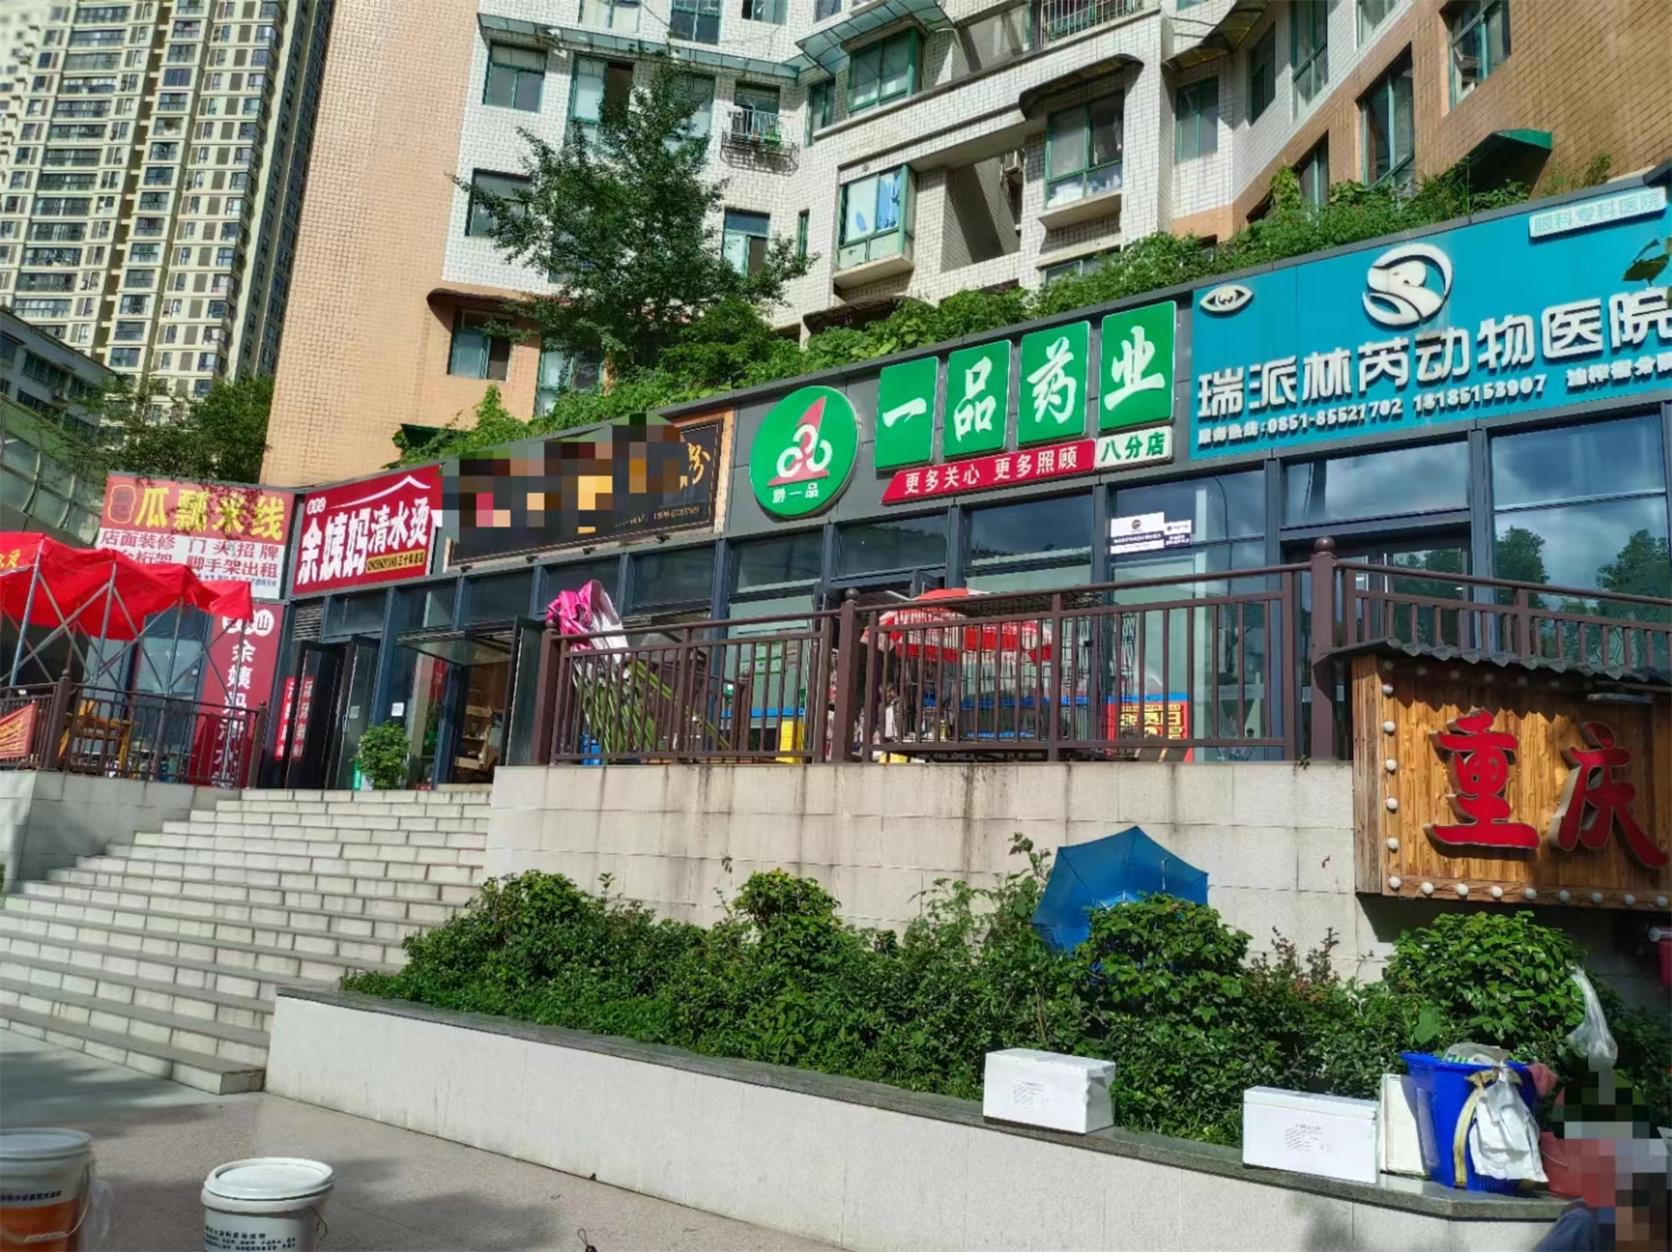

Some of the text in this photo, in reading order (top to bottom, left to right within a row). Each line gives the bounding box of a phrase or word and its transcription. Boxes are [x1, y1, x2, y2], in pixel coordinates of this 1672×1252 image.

[1198, 287, 1672, 418] 瑞派林芮动物医院
[882, 326, 1166, 442] 一品药业
[904, 446, 1079, 495] 更多关心 更多照顾
[1101, 430, 1166, 462] 八分店
[134, 487, 285, 541] 瓜瓢米线
[101, 530, 280, 561] 店面装修 门头招牌
[186, 555, 279, 579] 脚手架出租
[1425, 704, 1671, 871] 重庆
